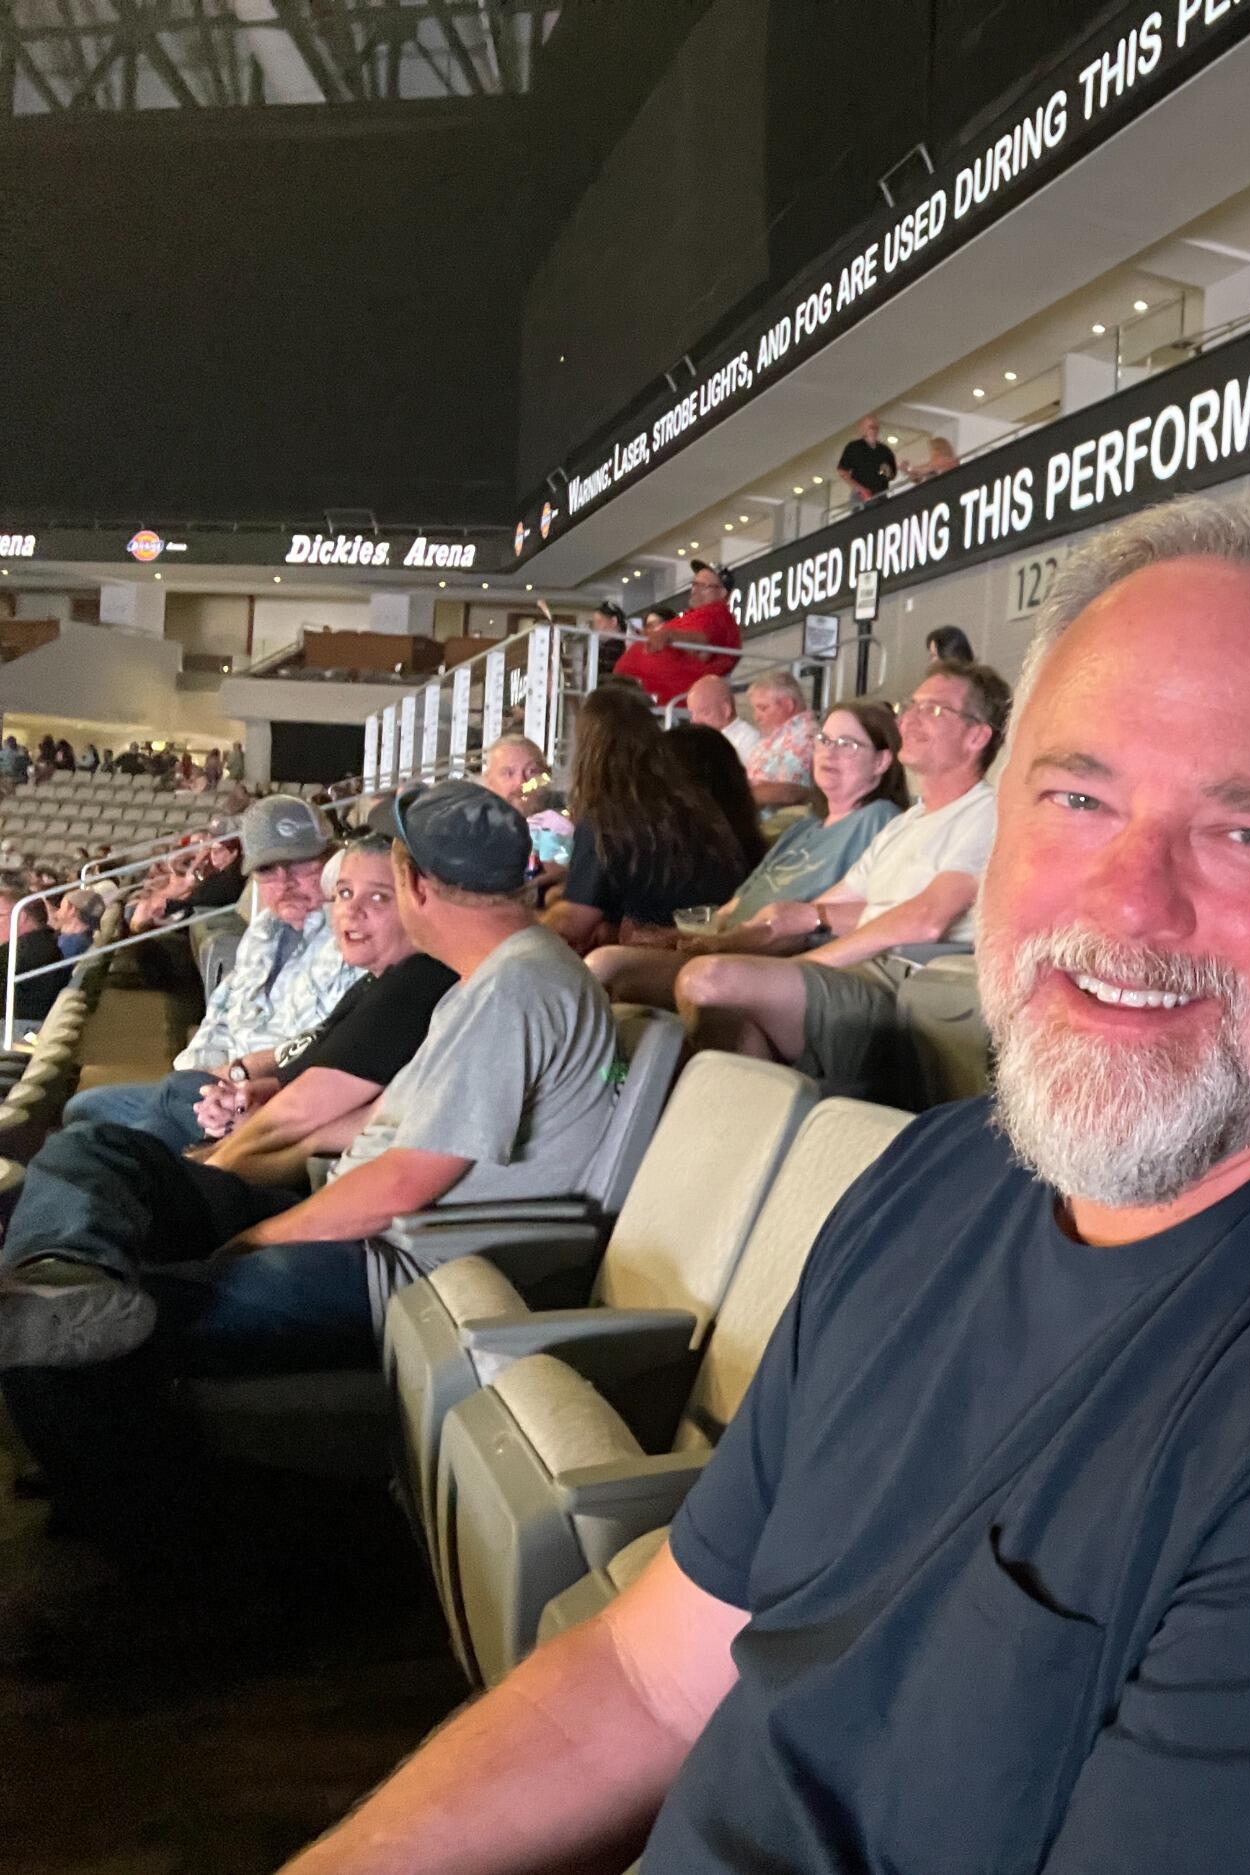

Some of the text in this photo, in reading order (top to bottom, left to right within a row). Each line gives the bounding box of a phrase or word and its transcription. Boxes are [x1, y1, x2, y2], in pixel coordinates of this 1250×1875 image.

[652, 390, 699, 452] STROBE
[699, 350, 753, 417] LIGHTS,
[756, 316, 792, 374] AND
[794, 282, 833, 344] FOG
[836, 242, 879, 313] ARE
[884, 189, 947, 273] USED
[954, 90, 1067, 220] DURING
[1079, 11, 1162, 120] THIS
[0, 534, 36, 557] ena
[285, 534, 476, 567] Dickies Arena
[744, 571, 783, 626] ARE
[786, 547, 843, 611] USED
[848, 502, 950, 589] DURING
[959, 467, 1034, 549] THIS
